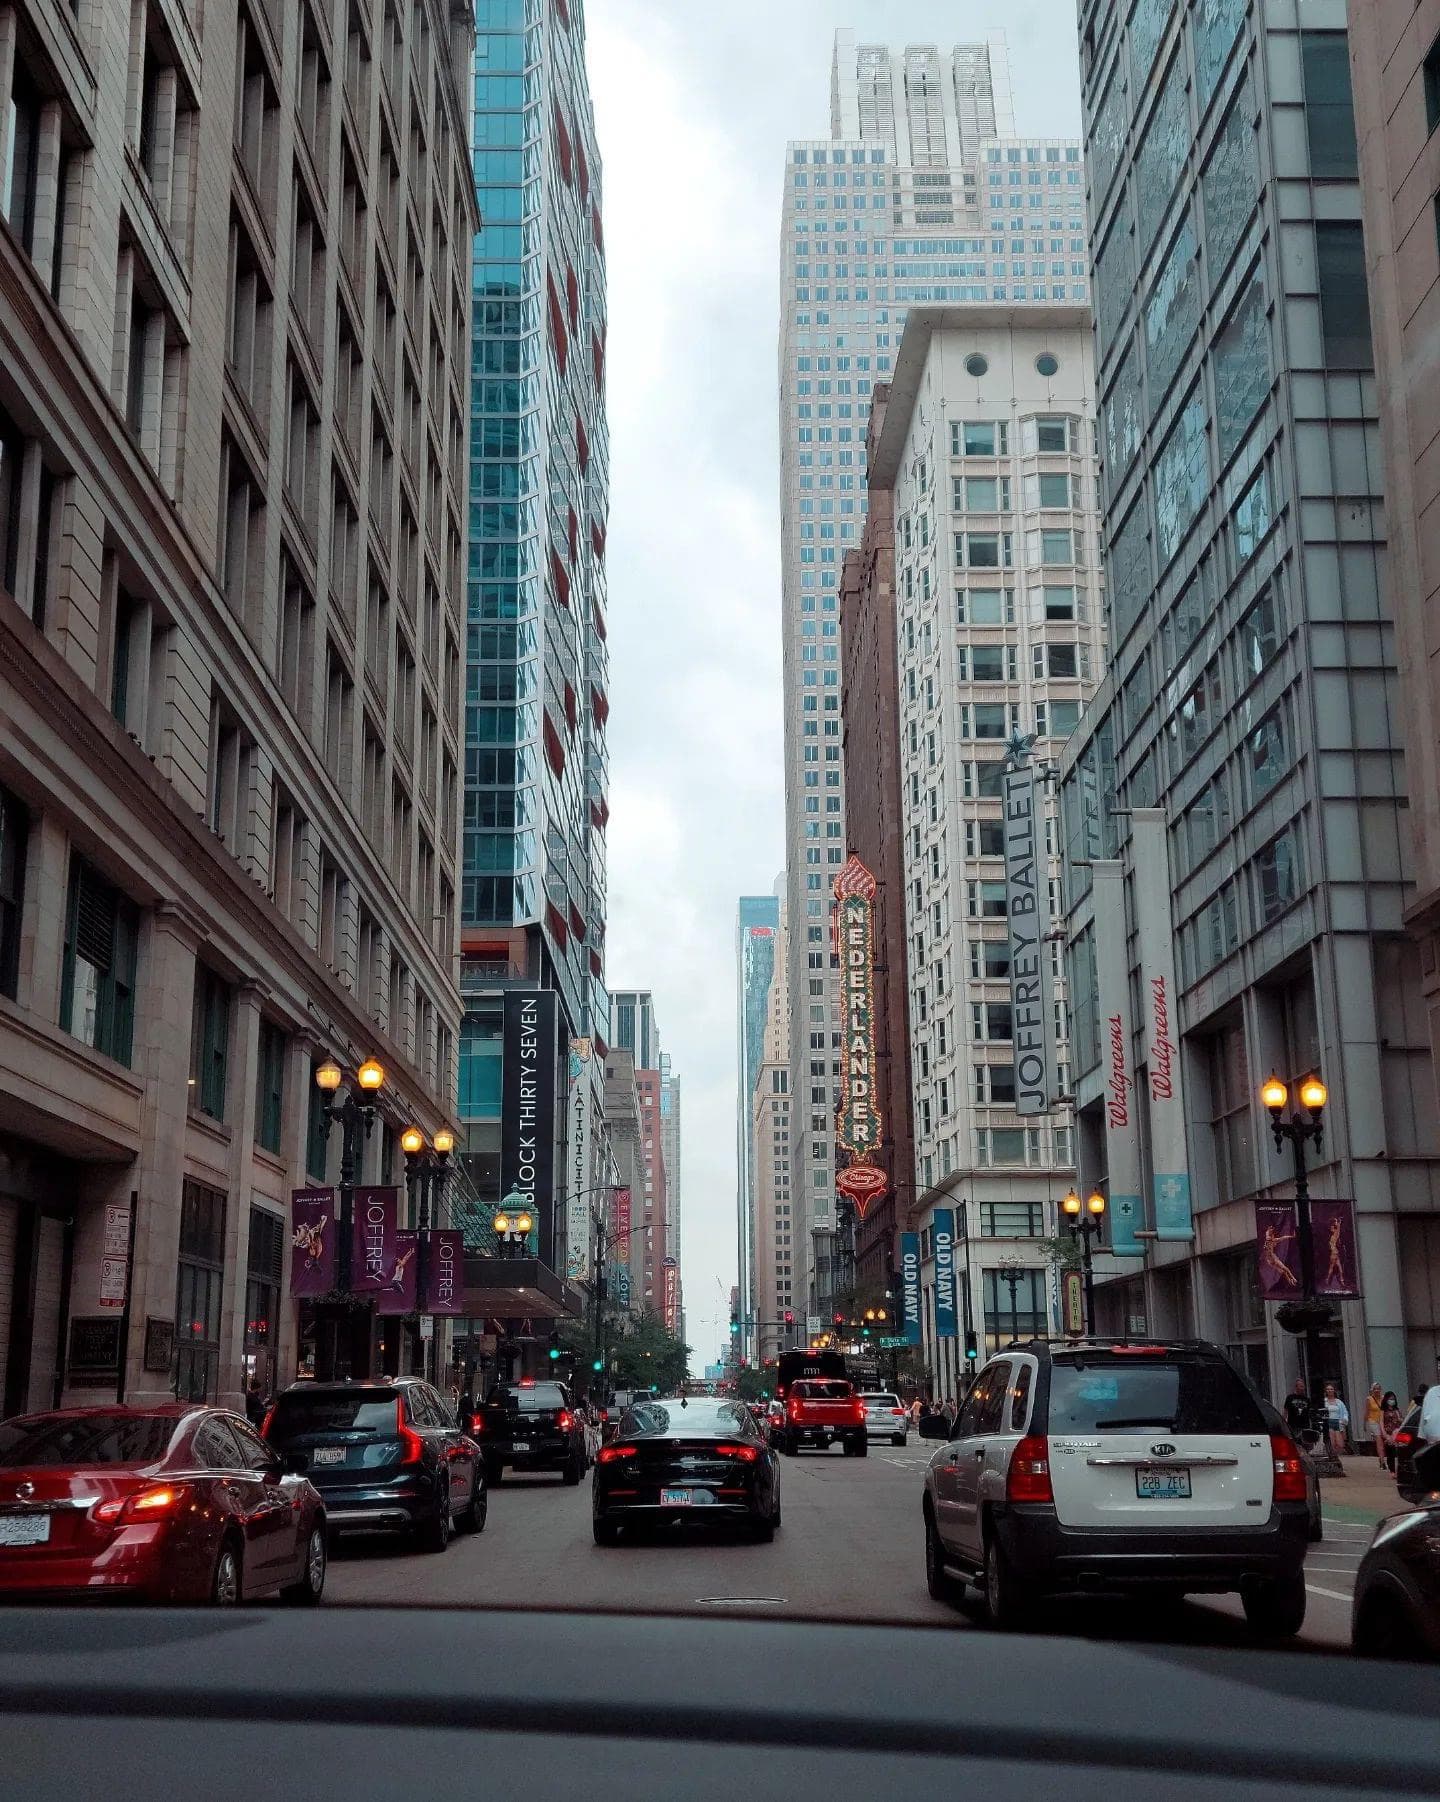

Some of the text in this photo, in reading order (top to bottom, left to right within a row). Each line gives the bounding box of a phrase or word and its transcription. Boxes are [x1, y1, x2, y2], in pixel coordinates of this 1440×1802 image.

[1006, 777, 1045, 1108] JOFFREY BALLET
[521, 1000, 537, 1059] SEVEN
[847, 907, 869, 1141] NEDERLANDER
[1150, 975, 1177, 1102] Walgreens
[519, 1066, 537, 1130] THIRTY
[1108, 1014, 1132, 1129] Walgreens
[574, 1085, 584, 1203] LATINICITY
[366, 1195, 385, 1283] JOFFREY
[438, 1237, 454, 1307] JOFFREY
[936, 1232, 953, 1312] OLD NAVY
[903, 1253, 919, 1324] OLD NAVY
[1167, 1476, 1185, 1490] ZEC
